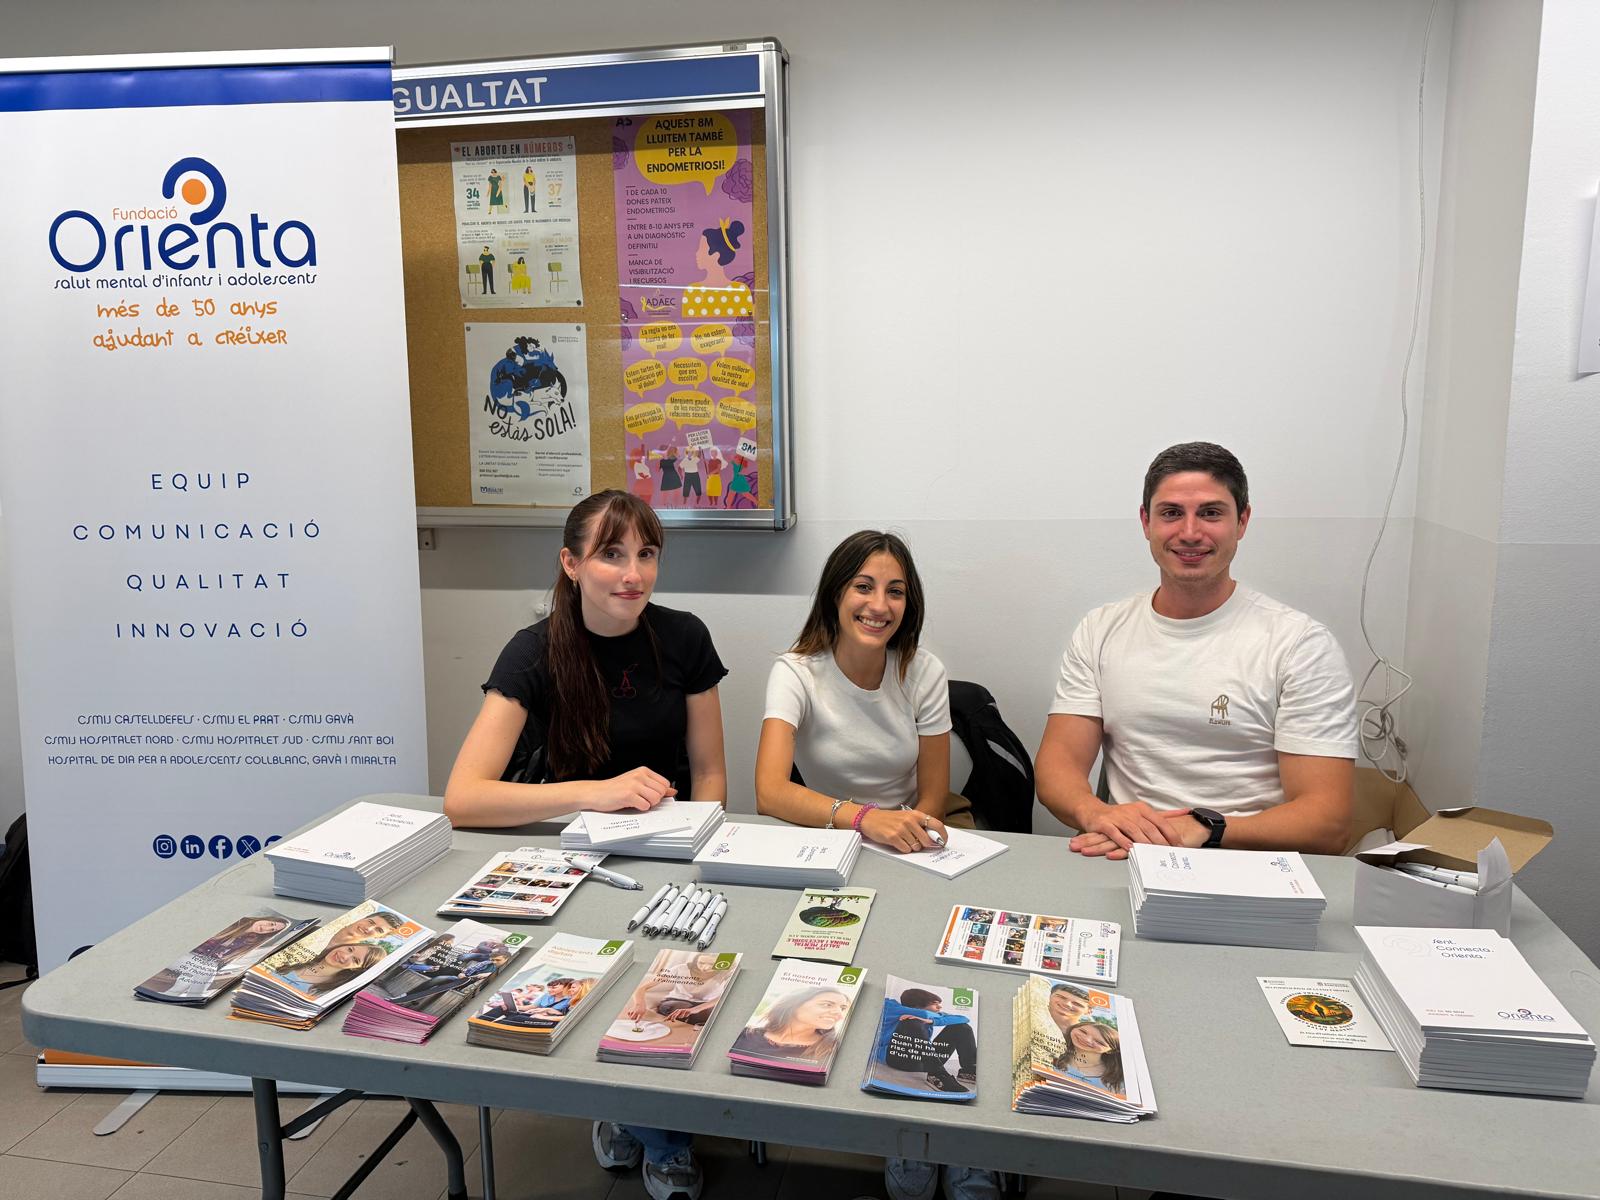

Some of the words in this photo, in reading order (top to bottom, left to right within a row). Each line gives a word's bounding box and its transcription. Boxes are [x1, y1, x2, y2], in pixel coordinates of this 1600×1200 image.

[655, 118, 694, 131] AQUEST
[697, 117, 714, 127] 8M
[646, 134, 687, 144] LLUITEM
[689, 128, 724, 141] TAMBÉ
[462, 146, 471, 157] EL
[475, 144, 507, 156] ABORTO
[511, 144, 520, 154] EN
[524, 141, 563, 154] NÚMEROS
[668, 147, 686, 157] PER
[689, 146, 702, 156] LA
[646, 159, 725, 173] ENDOMETRIOSI!
[466, 188, 480, 199] 34
[547, 183, 563, 197] 37
[650, 197, 672, 205] PATEIX
[113, 206, 178, 221] Fundació
[626, 207, 676, 215] ENDOMETRIOSI
[627, 223, 647, 231] ENTRE
[49, 208, 317, 273] Orienta
[54, 275, 91, 289] salut
[96, 274, 148, 288] mental
[152, 273, 212, 287] d'infants
[218, 273, 222, 286] i
[228, 272, 317, 286] adolescents
[97, 299, 140, 318] més
[156, 297, 180, 317] de
[192, 299, 216, 316] 50
[230, 299, 278, 317] anys
[93, 327, 175, 351] ajudant
[188, 331, 202, 346] a
[483, 395, 508, 419] NO
[534, 402, 577, 440] SOLA!
[151, 473, 250, 492] EQUIP
[73, 519, 321, 541] COMUNICACIÓ
[126, 573, 291, 592] QUALITAT
[116, 618, 308, 638] INNOVACIÓ
[78, 715, 112, 725] CSMIJ
[114, 714, 195, 725] CASTELLDEFELS
[203, 714, 235, 725] CSMIJ
[238, 714, 250, 725] EL
[253, 714, 280, 724] PRAT
[288, 714, 322, 724] CSMIJ
[325, 712, 354, 724] GAVÀ
[44, 736, 76, 745] CSMIJ
[79, 735, 142, 745] HOSPITALET
[145, 735, 174, 745] NORD
[182, 735, 214, 745] CSMIJ
[217, 735, 279, 745] HOSPITALET
[282, 735, 303, 745] SUD
[312, 735, 345, 745] CSMIJ
[348, 735, 373, 745] SANT
[376, 736, 394, 745] BOI
[48, 755, 98, 765] HOSPITAL
[101, 755, 115, 764] DE
[118, 755, 135, 764] DIA
[138, 755, 157, 764] PER
[160, 755, 167, 764] A
[170, 755, 241, 765] ADOLESCENTS
[245, 755, 310, 766] COLLBLANC,
[312, 753, 342, 764] GAVÀ
[351, 755, 397, 765] MIRALTA
[1436, 945, 1495, 953] Connecta.
[1441, 952, 1487, 960] Orienta.
[1497, 1009, 1555, 1022] Orienta
[891, 1038, 913, 1049] Quan
[915, 1041, 923, 1050] hi
[892, 1032, 912, 1042] Com
[914, 1036, 950, 1048] prevenir
[889, 1050, 909, 1059] d'un
[911, 1053, 922, 1061] fill
[908, 1047, 919, 1055] de
